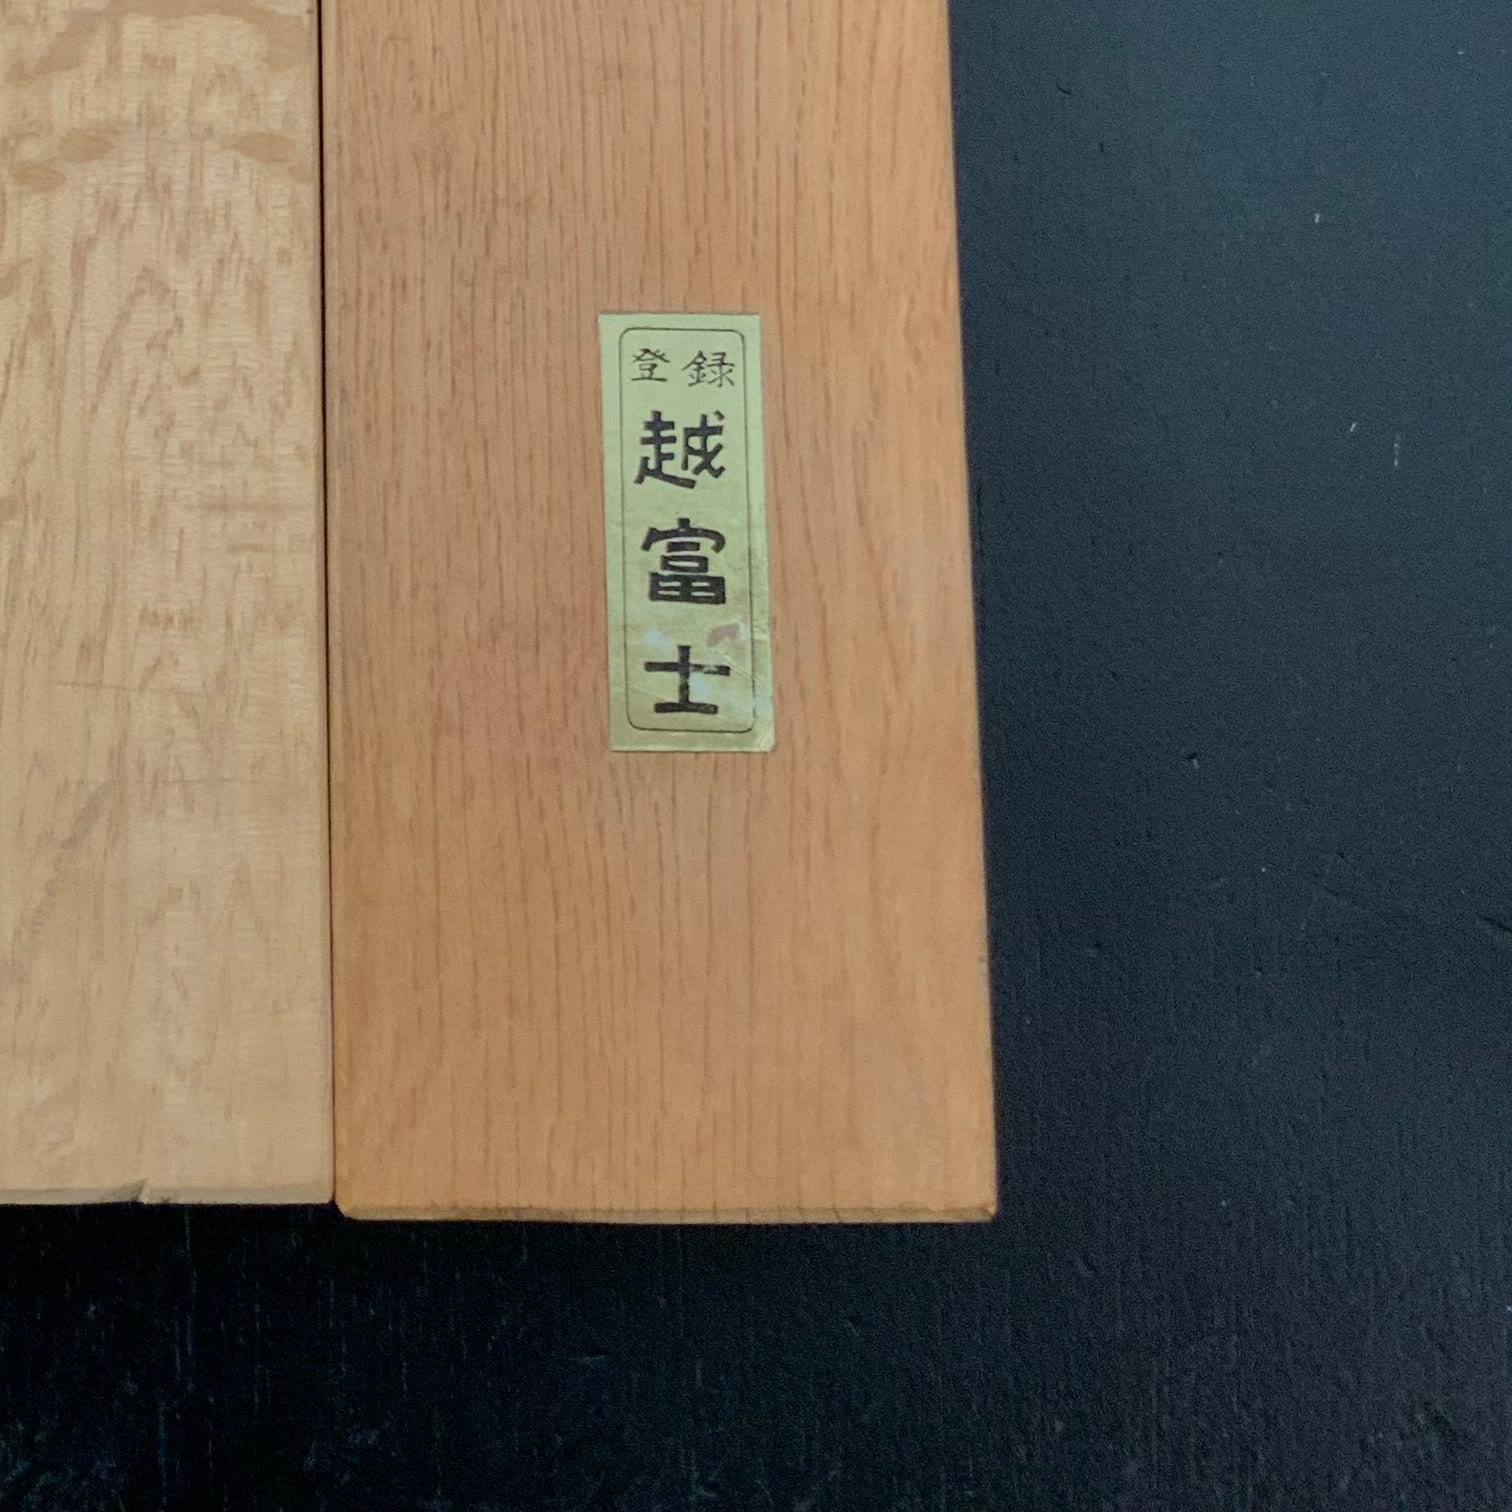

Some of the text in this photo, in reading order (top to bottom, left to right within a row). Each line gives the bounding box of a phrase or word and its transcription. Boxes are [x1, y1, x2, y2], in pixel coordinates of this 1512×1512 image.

[630, 347, 736, 387] 登録
[633, 410, 731, 715] 越富士
